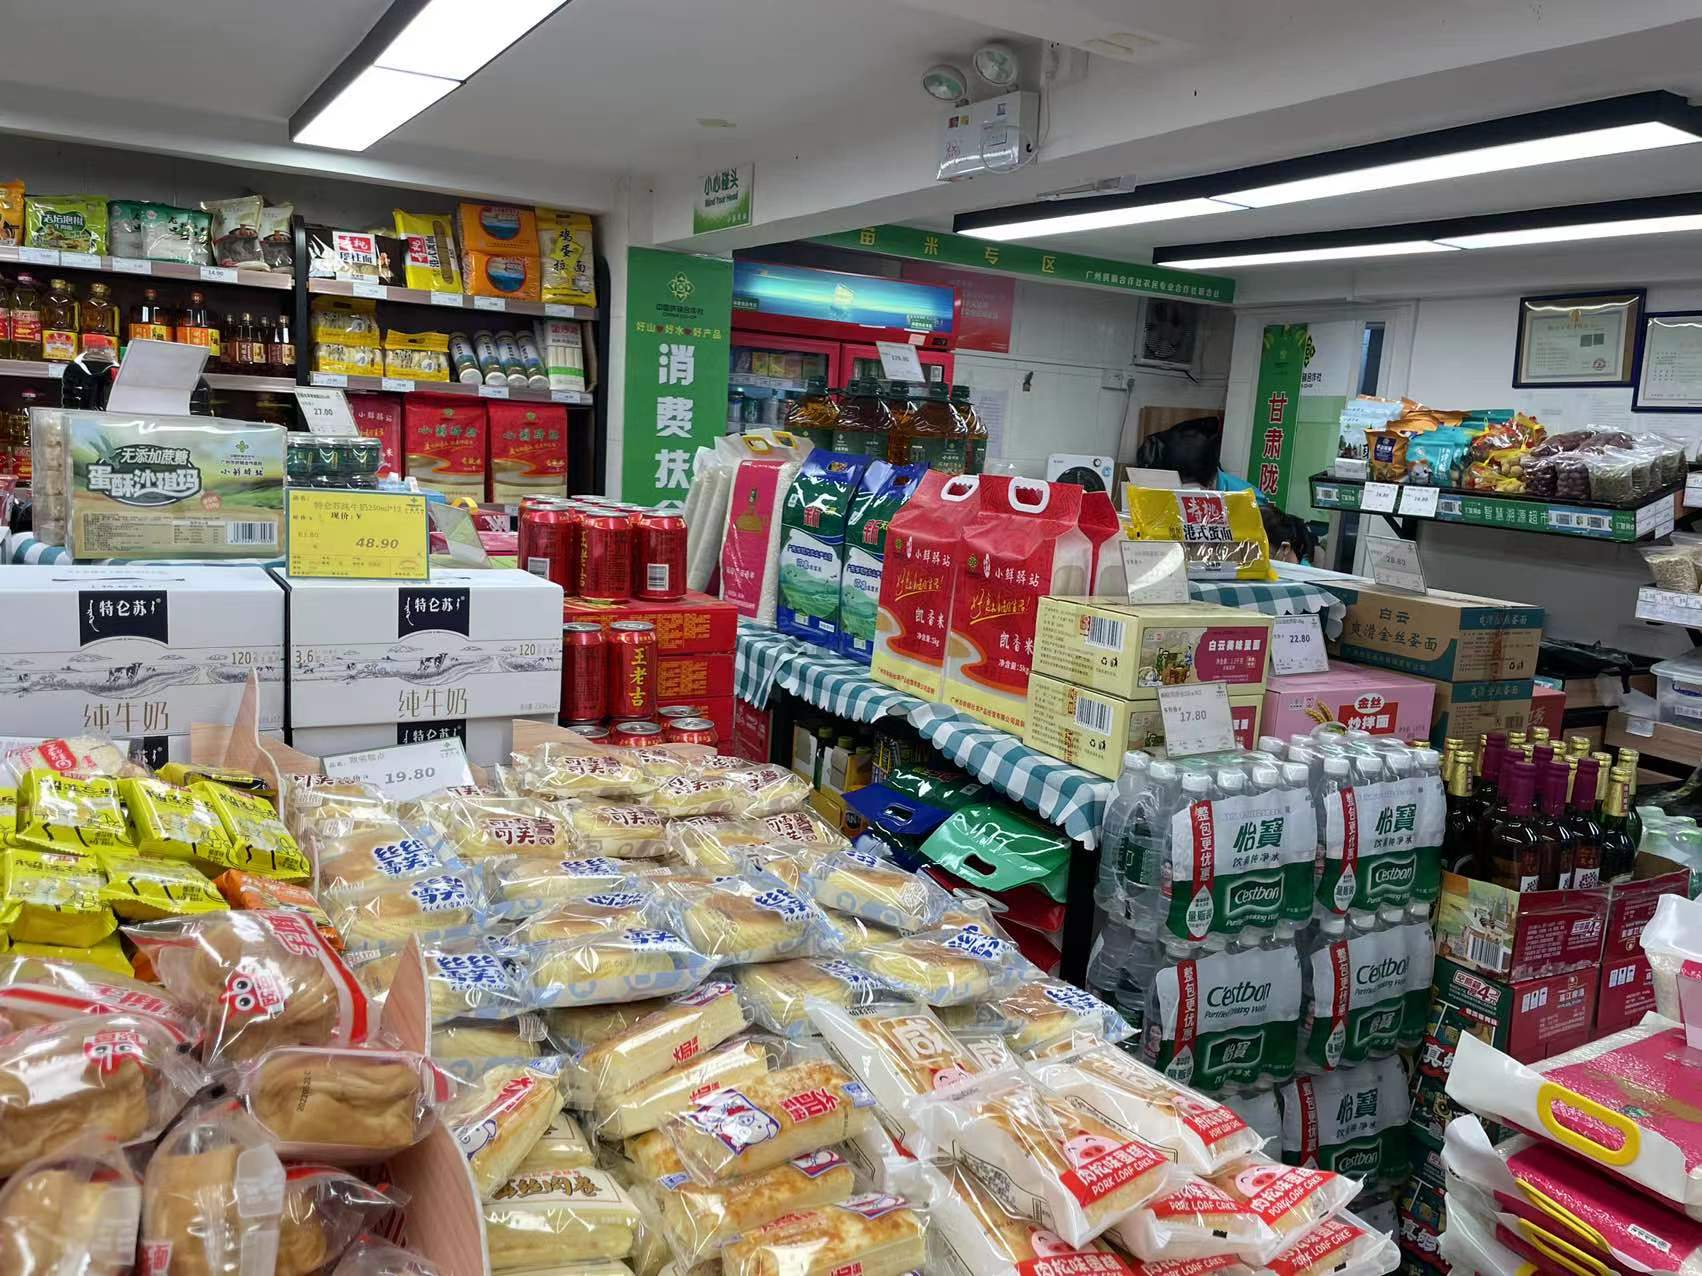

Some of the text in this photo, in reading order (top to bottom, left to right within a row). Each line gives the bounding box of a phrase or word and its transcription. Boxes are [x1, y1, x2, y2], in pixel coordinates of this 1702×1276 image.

[704, 168, 739, 195] 小心碰头
[655, 343, 696, 510] 消费扶
[120, 448, 191, 465] 无添加蔗糖
[1259, 392, 1288, 508] 甘肃陇
[1183, 525, 1233, 541] 港式蛋面
[356, 537, 399, 549] 48.90
[915, 548, 951, 567] 小鲜驿站
[995, 568, 1040, 587] 小鲜驿站
[100, 600, 147, 616] 特仑苏
[415, 598, 453, 613] 特仑苏
[1379, 607, 1410, 623] 白云
[1289, 634, 1311, 643] 22.80
[232, 651, 251, 664] 120
[519, 644, 535, 656] 120
[630, 647, 648, 707] 王老吉
[399, 688, 467, 718] 纯牛奶
[1357, 696, 1382, 709] 金丝
[84, 701, 169, 733] 纯牛奶
[1180, 711, 1207, 722] 17.80
[384, 767, 436, 784] 19.80
[1077, 1143, 1152, 1185] 肉松味蛋糕
[1091, 1158, 1154, 1197] PORK LOAF CAKE
[1303, 1174, 1323, 1191] CAKE
[1192, 1200, 1214, 1211] LOAF
[1216, 1200, 1238, 1211] CAKE
[1311, 1242, 1332, 1257] LOAF
[1331, 1230, 1352, 1245] CAKE
[1206, 1257, 1227, 1269] CAKE
